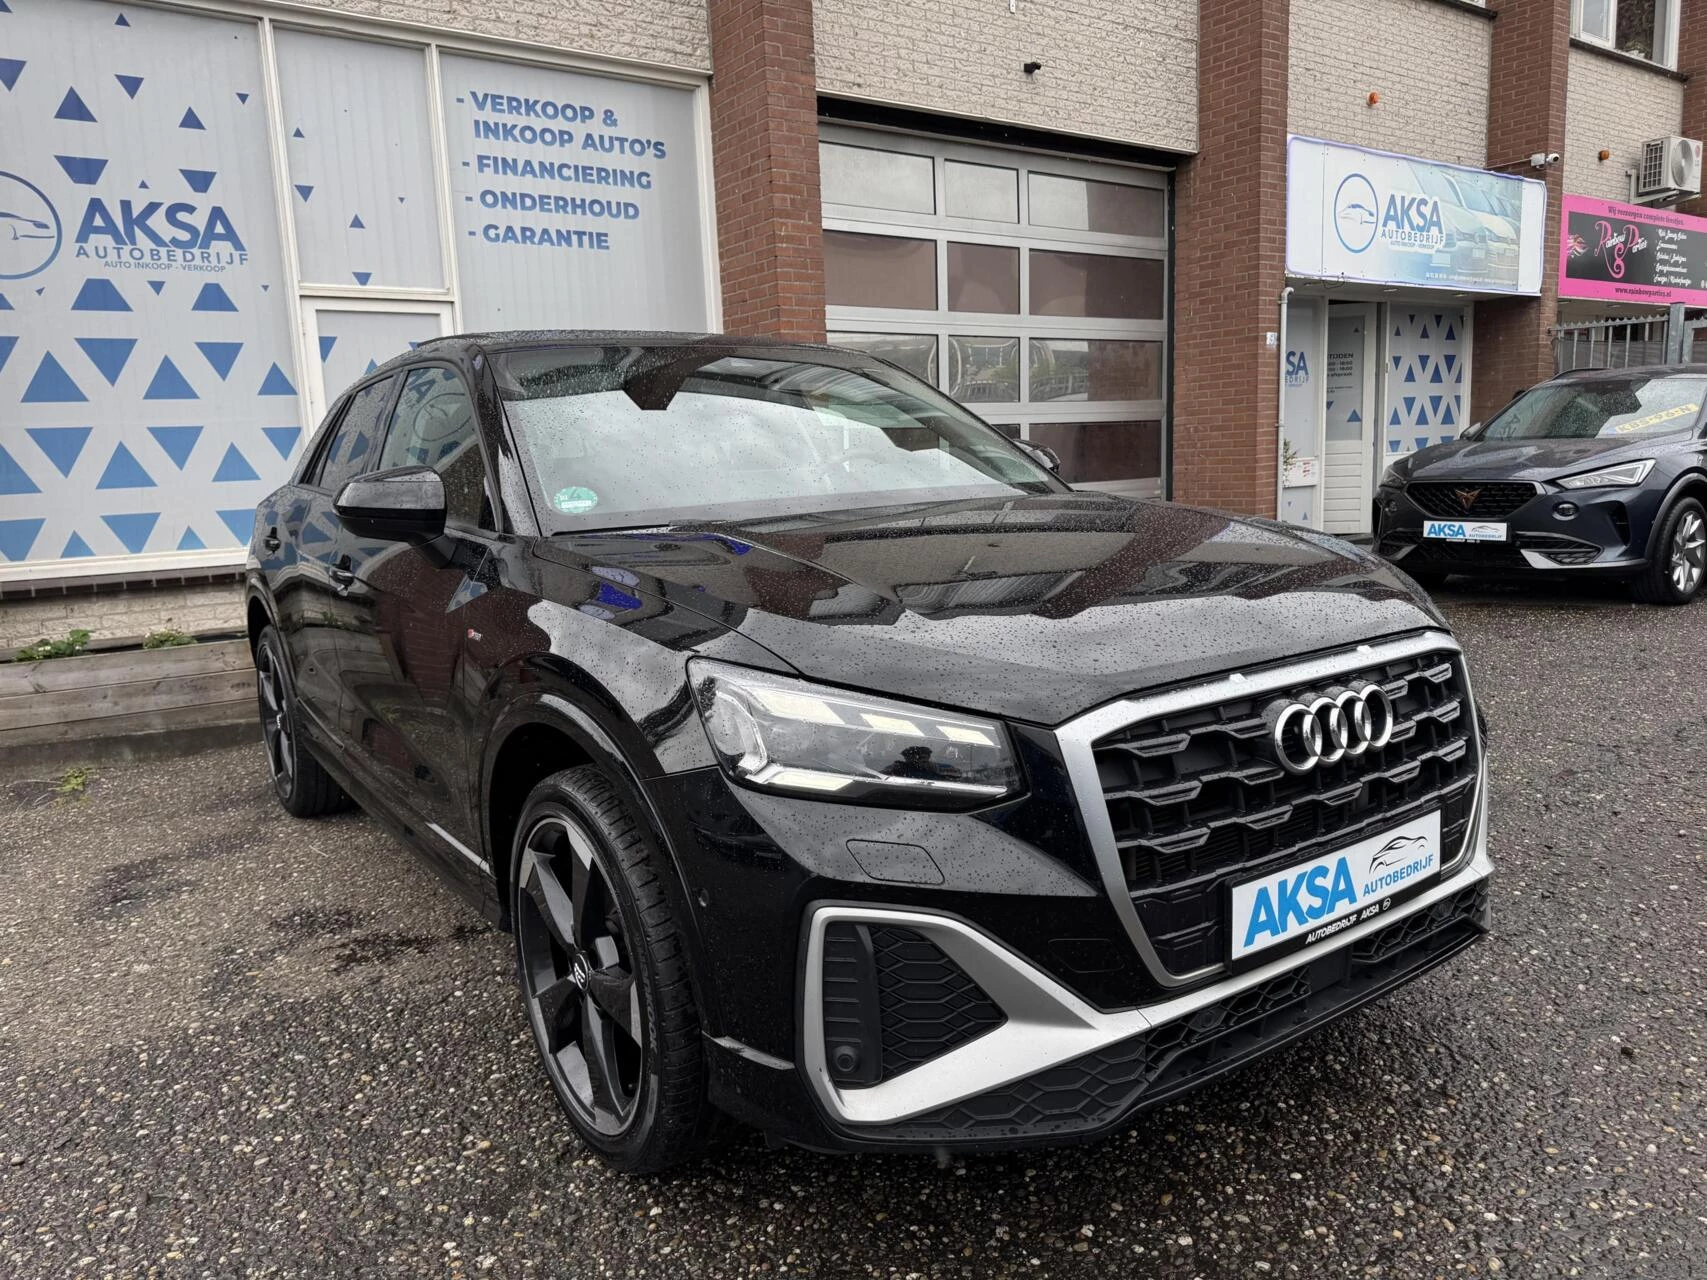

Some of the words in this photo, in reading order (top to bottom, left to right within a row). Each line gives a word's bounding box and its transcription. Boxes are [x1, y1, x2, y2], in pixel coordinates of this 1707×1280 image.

[470, 91, 595, 124] VERKOOP
[602, 109, 618, 128] &
[473, 119, 574, 148] INKOOP
[581, 133, 666, 159] AUTO'S
[476, 154, 652, 189] FINANCIERING
[479, 189, 640, 220] ONDERHOUD
[1382, 193, 1444, 234] AKSA
[74, 197, 247, 252] AKSA
[482, 223, 610, 250] GARANTIE
[1381, 229, 1445, 245] AUTOBEDRIJF
[75, 245, 249, 266] AUTOBEDRIJF
[103, 260, 132, 269] AUTO
[134, 261, 173, 271] INKOOP
[181, 263, 226, 273] VERKOOP
[1285, 350, 1309, 376] SA
[1427, 522, 1466, 538] AKSA
[1362, 854, 1434, 897] AUTOBEDRIJF
[1243, 856, 1357, 948] AKSA
[1305, 914, 1358, 944] AUTOBEDRIJF
[1359, 905, 1380, 921] AKSA
